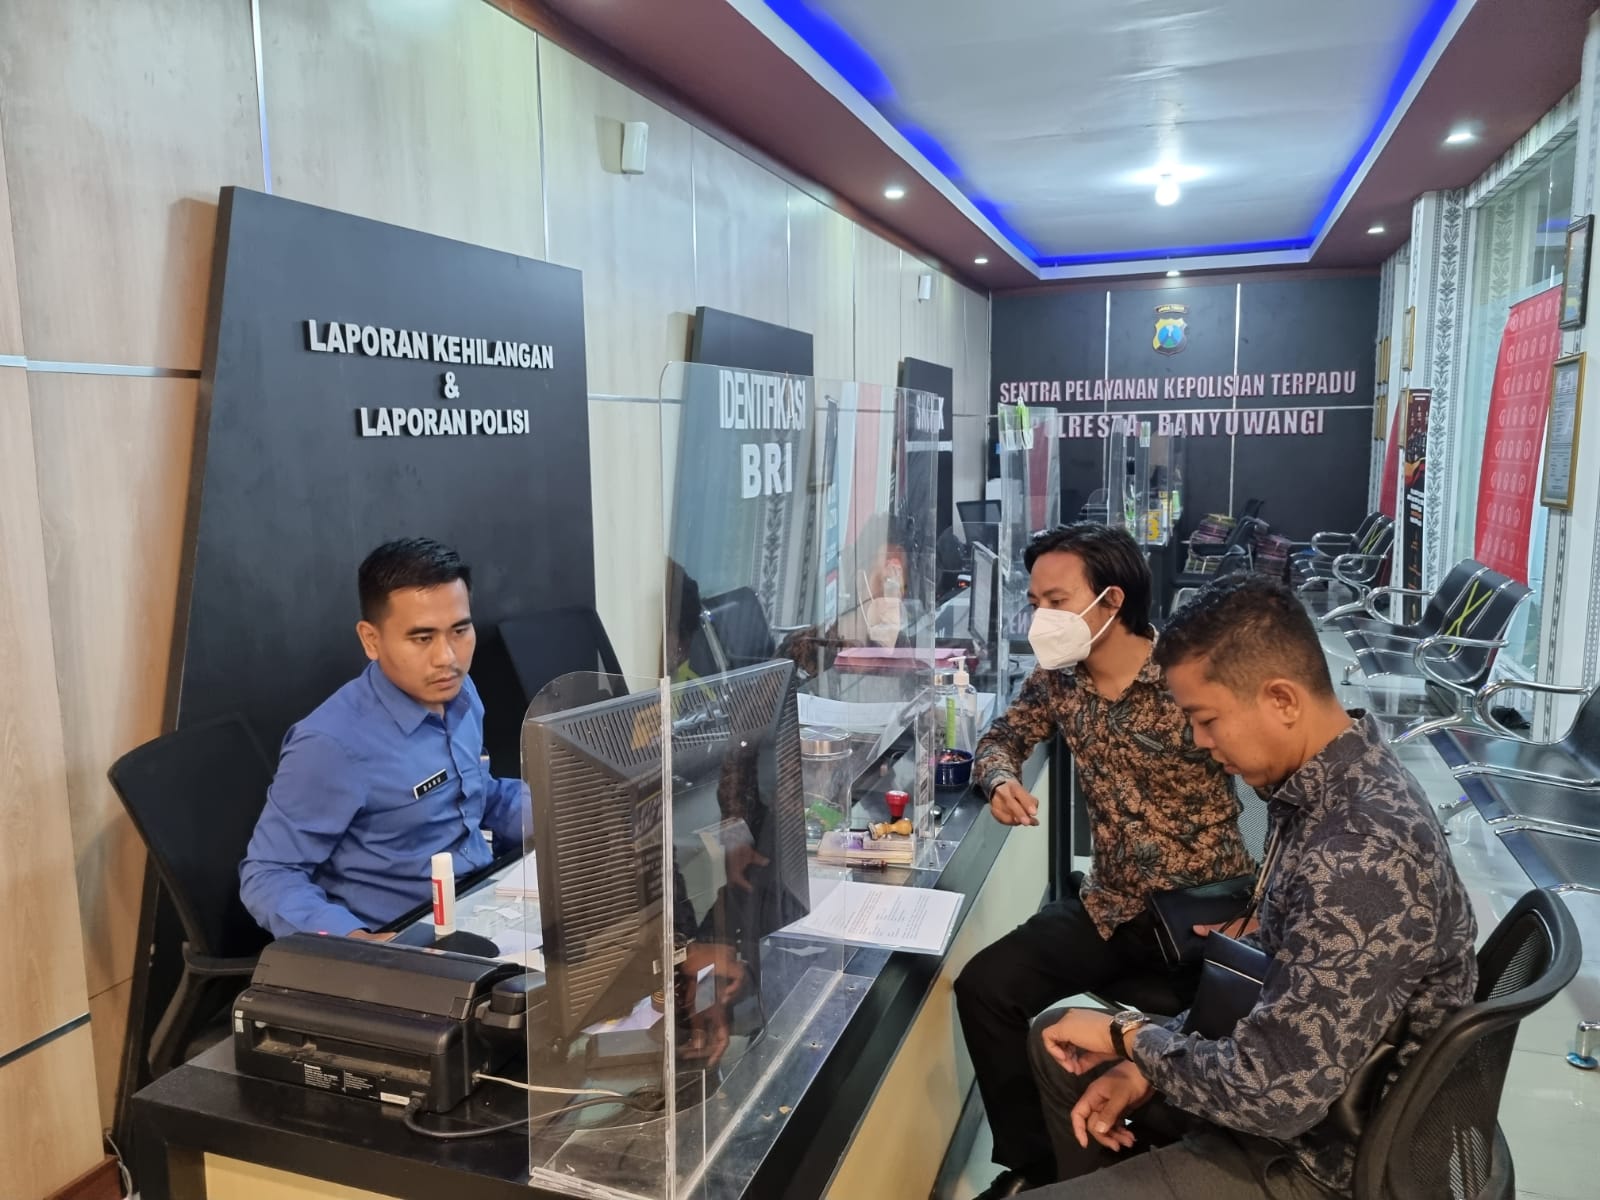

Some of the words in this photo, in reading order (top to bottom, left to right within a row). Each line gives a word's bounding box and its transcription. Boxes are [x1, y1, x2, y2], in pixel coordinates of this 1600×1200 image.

[308, 319, 429, 360] LAPORAN
[432, 333, 555, 369] KEHILANGAN
[443, 371, 460, 399] &
[719, 369, 806, 431] IDENTIFIKASI
[1000, 381, 1062, 403] SENTRA
[1065, 377, 1159, 401] PELAYANAN
[1163, 373, 1266, 399] KEPOLISIAN
[1271, 370, 1357, 396] TERPADU
[360, 407, 468, 437] LAPORAN
[470, 409, 530, 435] POLISI
[1158, 409, 1325, 437] BANYUWANGI
[741, 442, 793, 499] BRI
